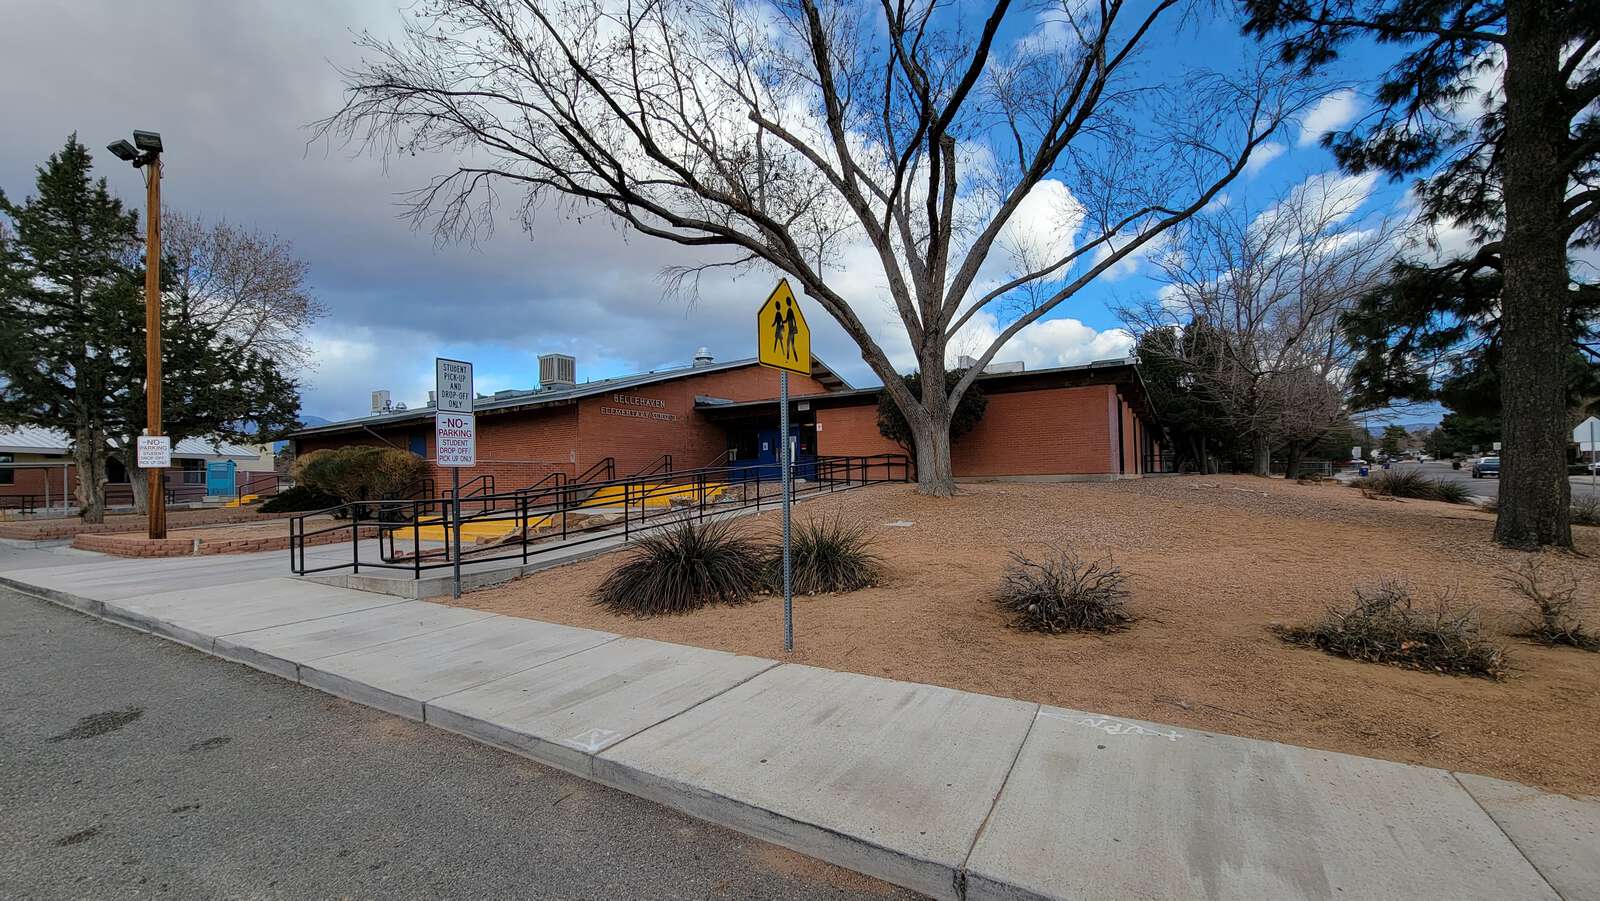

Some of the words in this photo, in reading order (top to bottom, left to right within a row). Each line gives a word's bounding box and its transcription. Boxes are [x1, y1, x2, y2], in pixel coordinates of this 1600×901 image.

[443, 364, 467, 373] STUDENT
[444, 373, 466, 382] PICK-UP
[450, 382, 462, 390] AND
[442, 390, 468, 400] DROP-OFF
[448, 400, 462, 408] ONLY
[613, 393, 666, 408] BELLEHAVEN
[438, 429, 472, 438] PARKING
